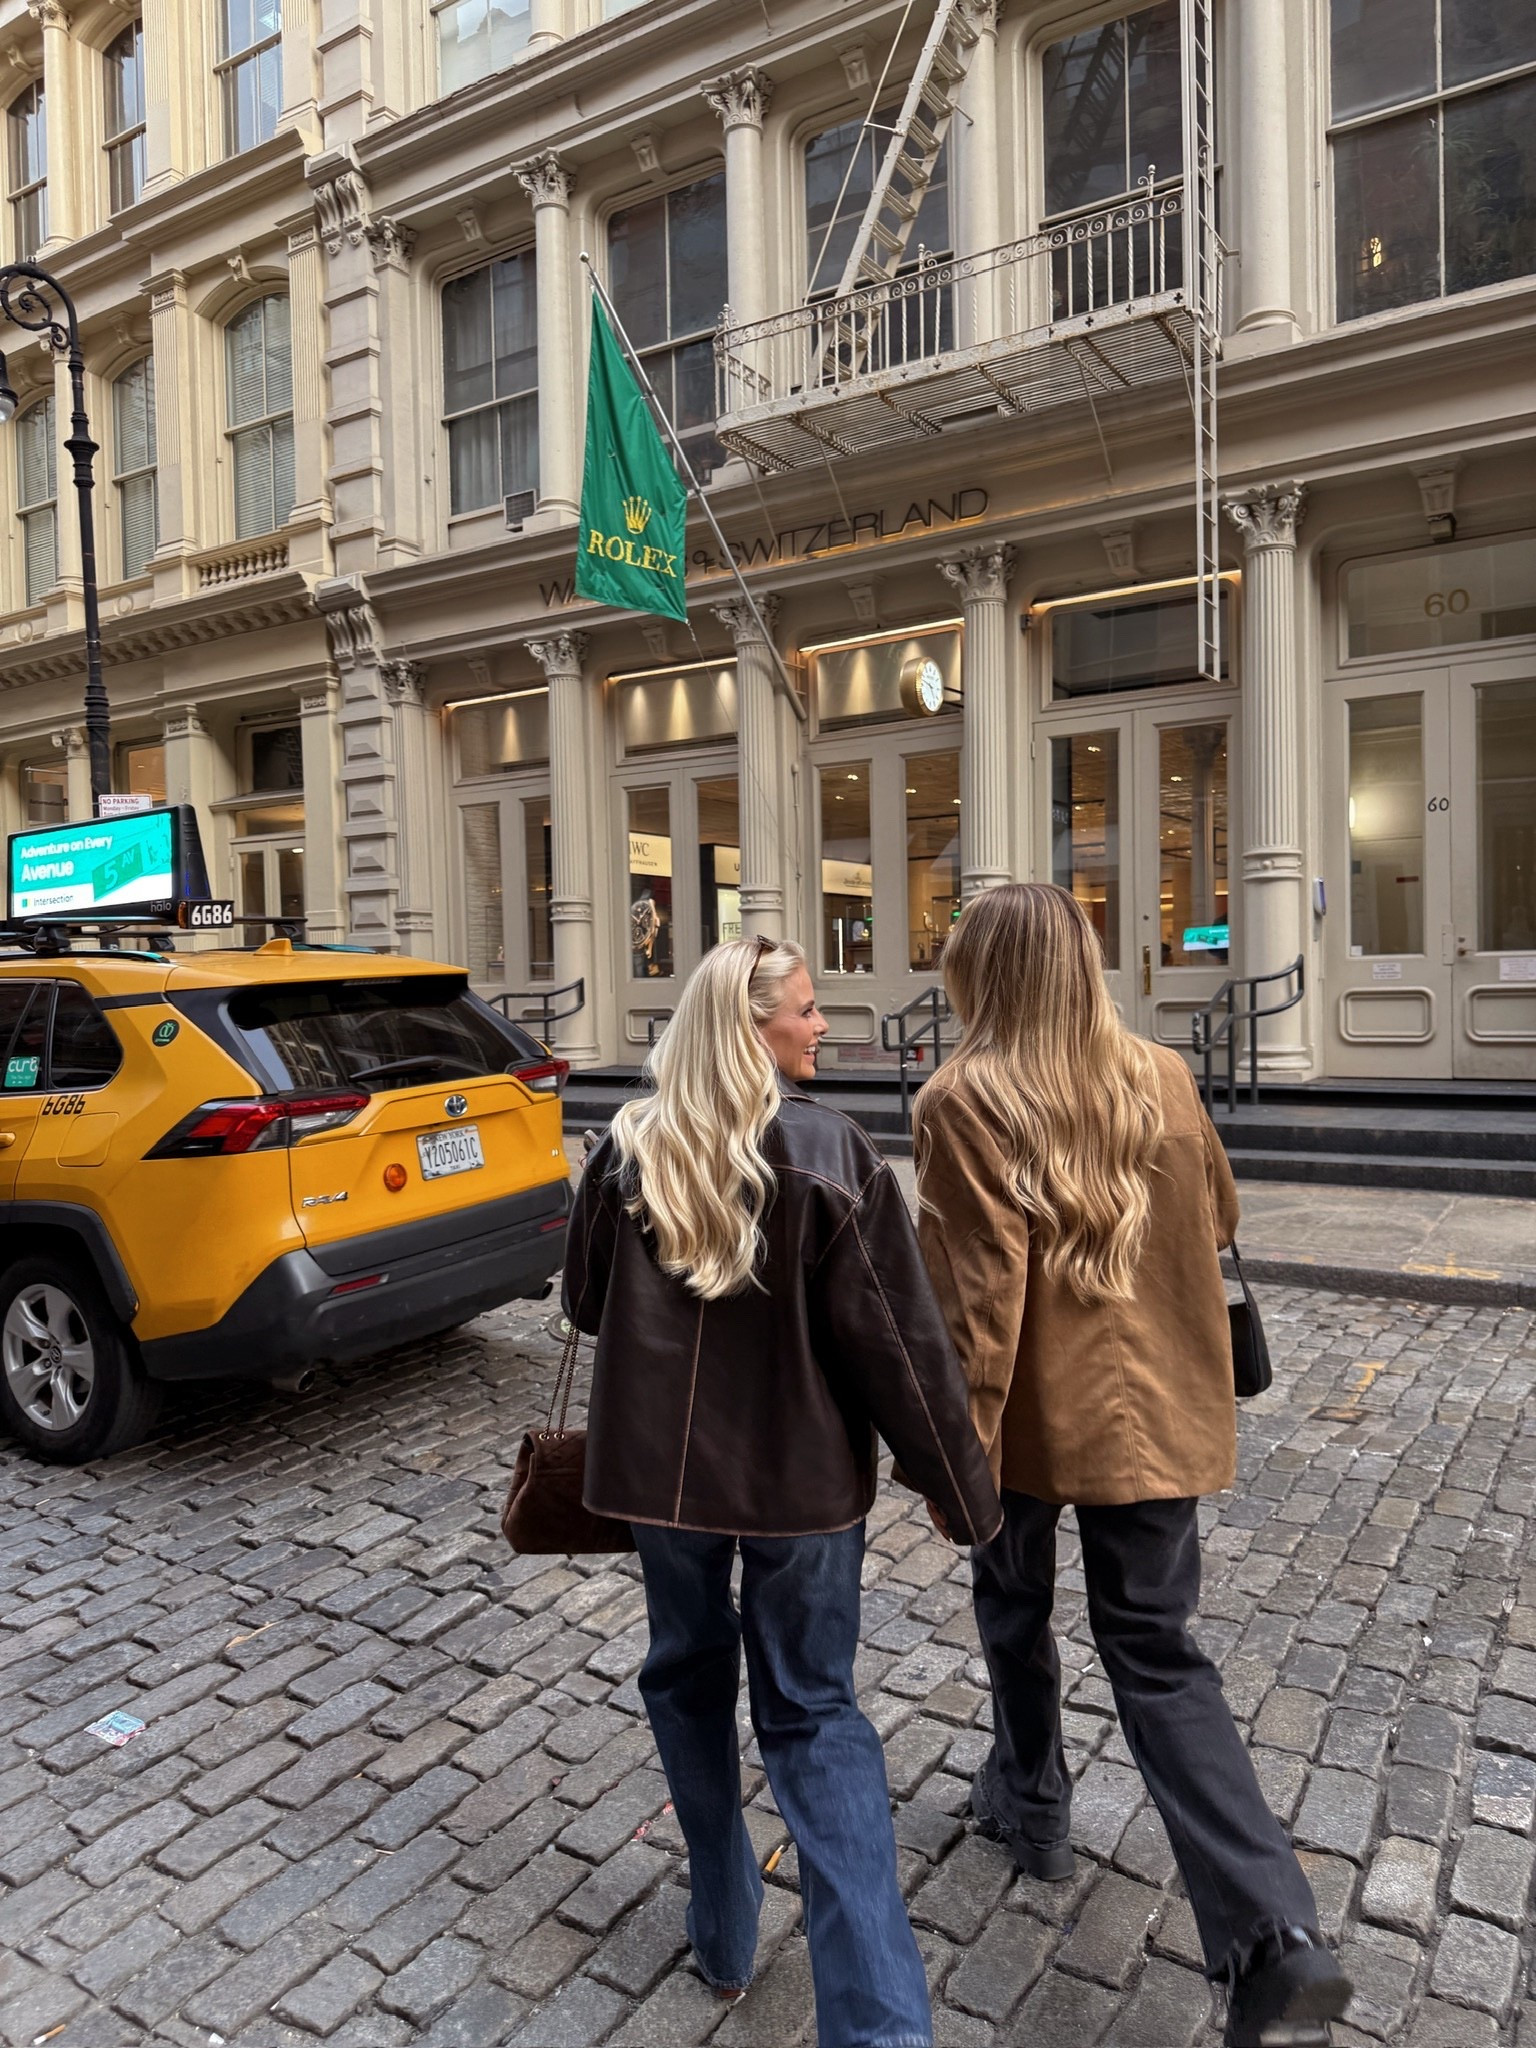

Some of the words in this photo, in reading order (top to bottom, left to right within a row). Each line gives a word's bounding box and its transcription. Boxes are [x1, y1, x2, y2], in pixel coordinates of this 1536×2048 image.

[719, 488, 989, 570] SWITZERLAND
[587, 529, 678, 577] ROLEX
[1424, 589, 1470, 618] 60
[1428, 796, 1449, 812] 60
[21, 842, 69, 859] Adventure
[71, 840, 84, 852] on
[85, 836, 113, 850] Every
[629, 841, 650, 857] WC
[21, 861, 75, 882] Avenue
[103, 861, 119, 891] 5
[121, 848, 135, 868] AV
[191, 904, 232, 925] 6G86
[42, 1094, 86, 1115] 6G86
[425, 1136, 478, 1169] Y205061C
